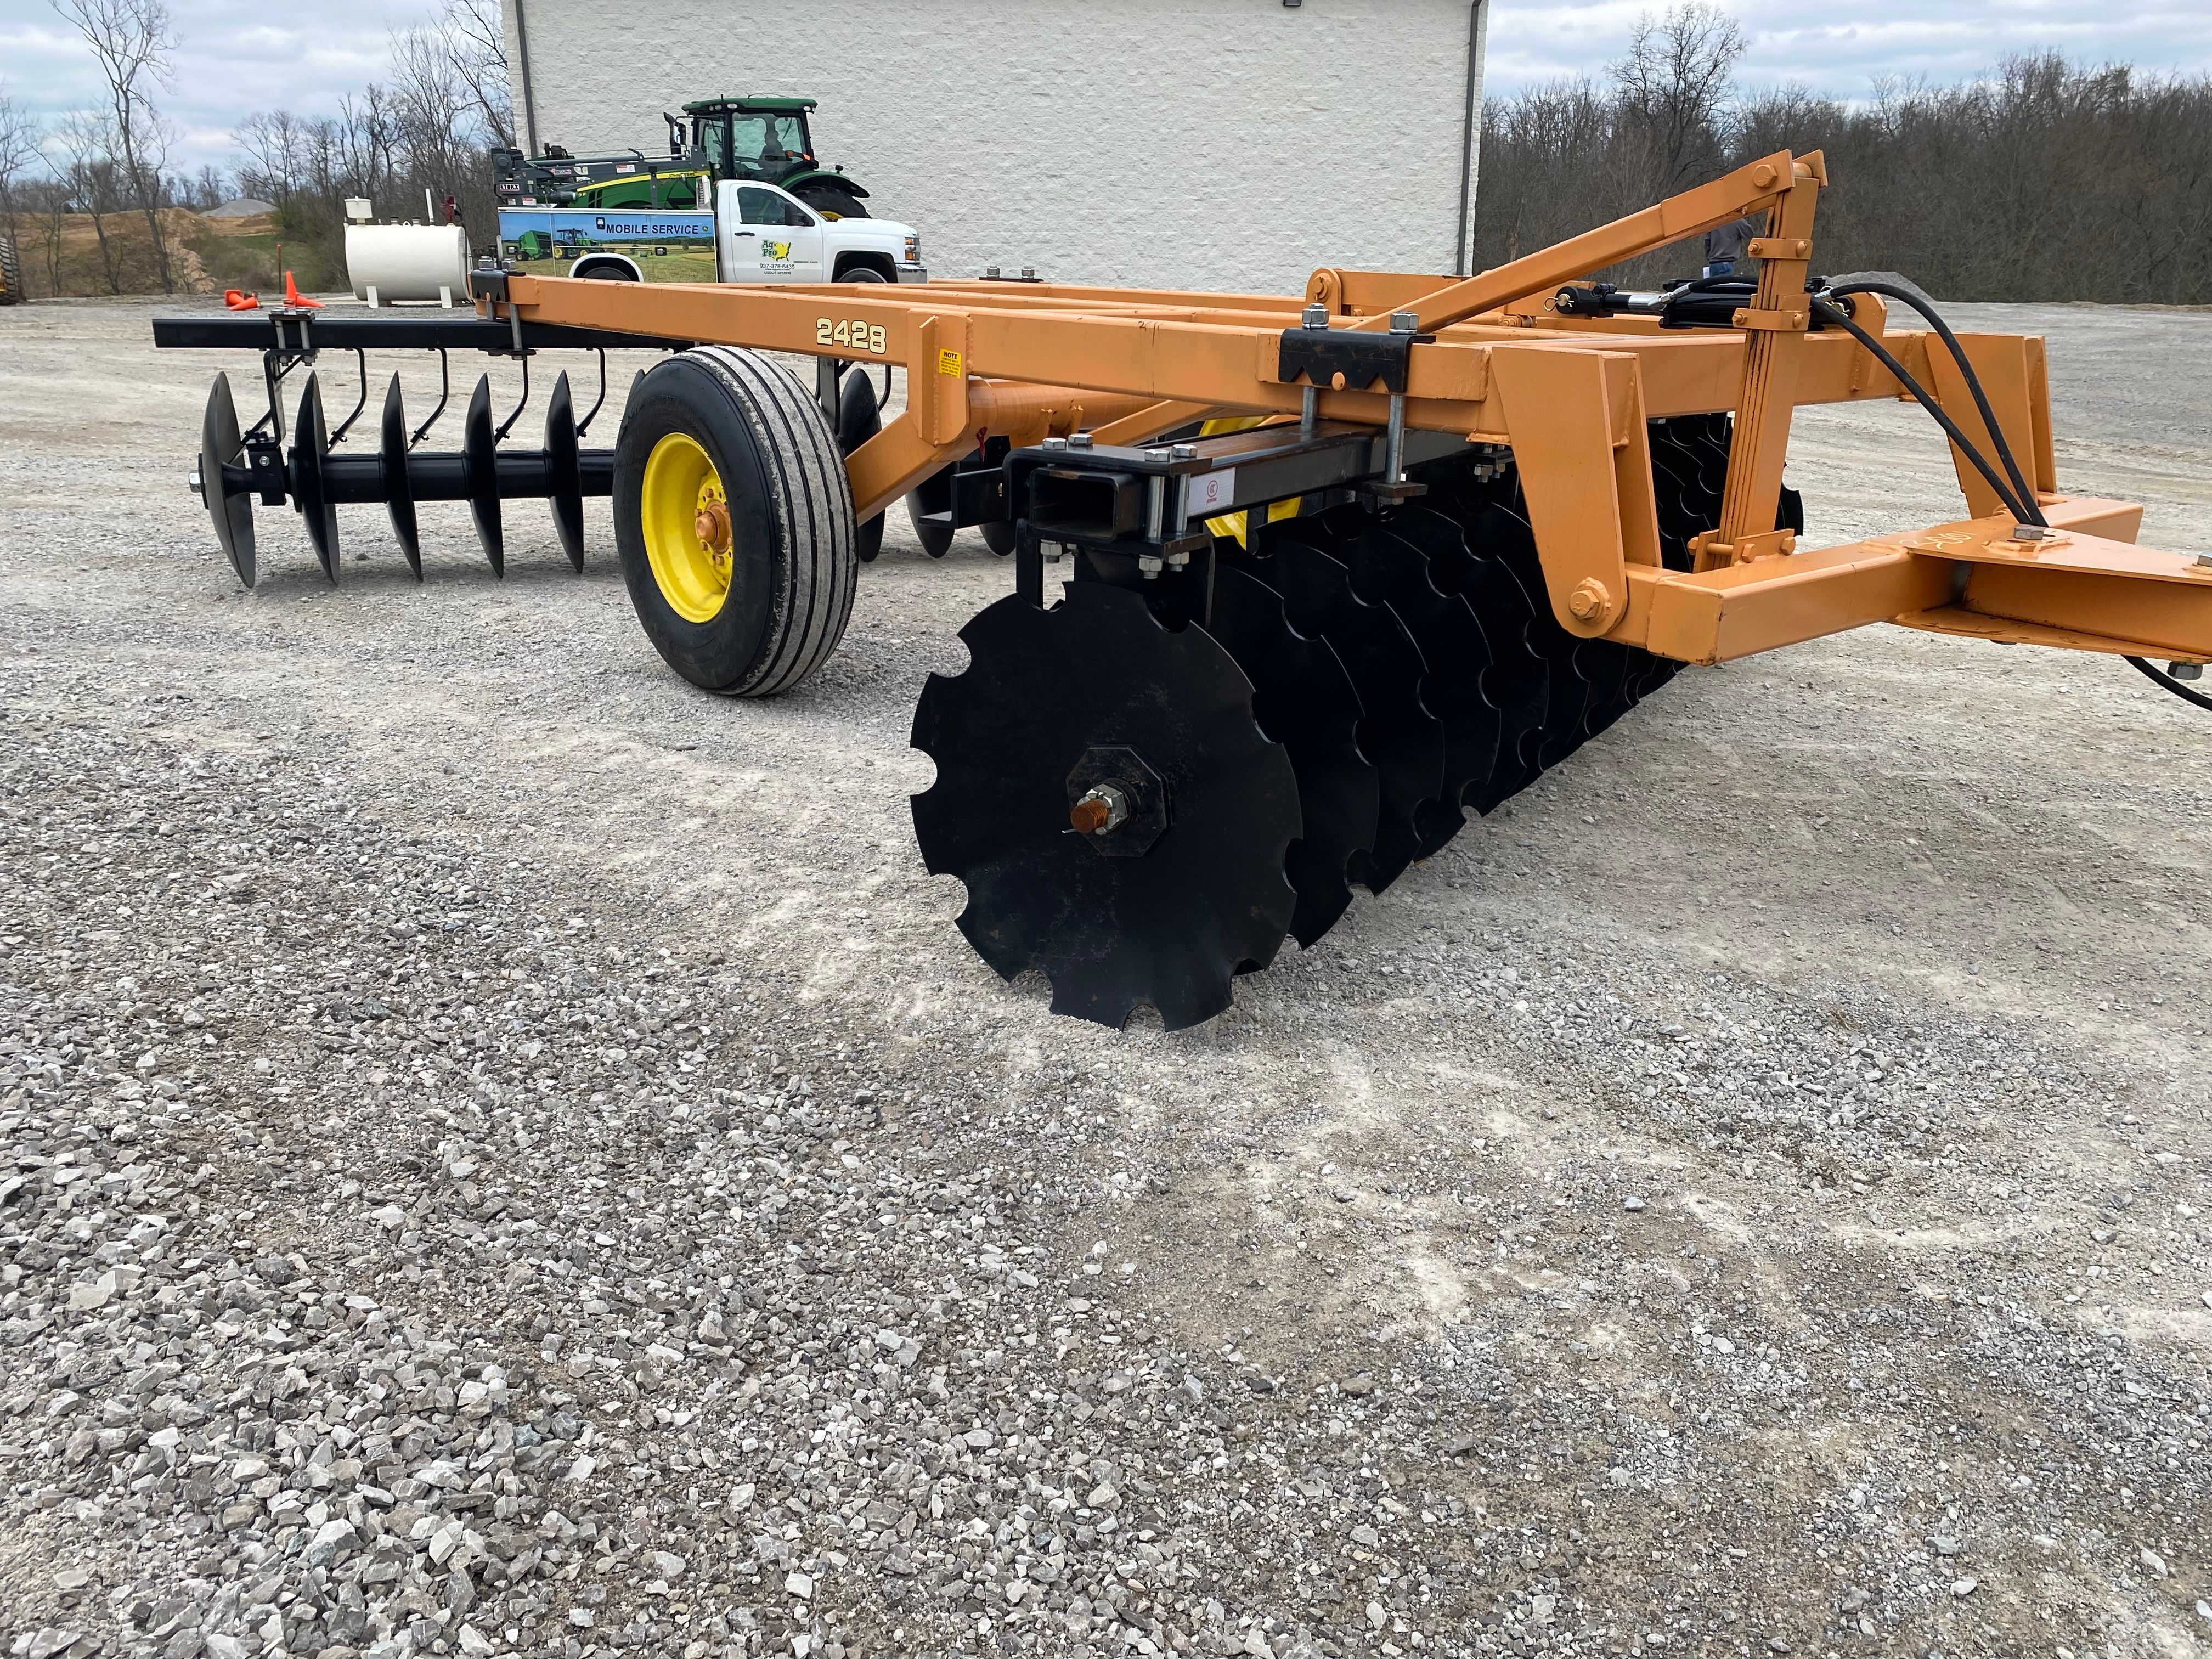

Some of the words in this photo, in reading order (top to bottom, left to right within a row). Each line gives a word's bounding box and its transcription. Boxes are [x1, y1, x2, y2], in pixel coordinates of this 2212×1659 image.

[606, 224, 648, 234] MOBILE
[652, 225, 698, 234] SERVICE
[816, 317, 886, 354] 2428
[944, 351, 958, 359] NOTE
